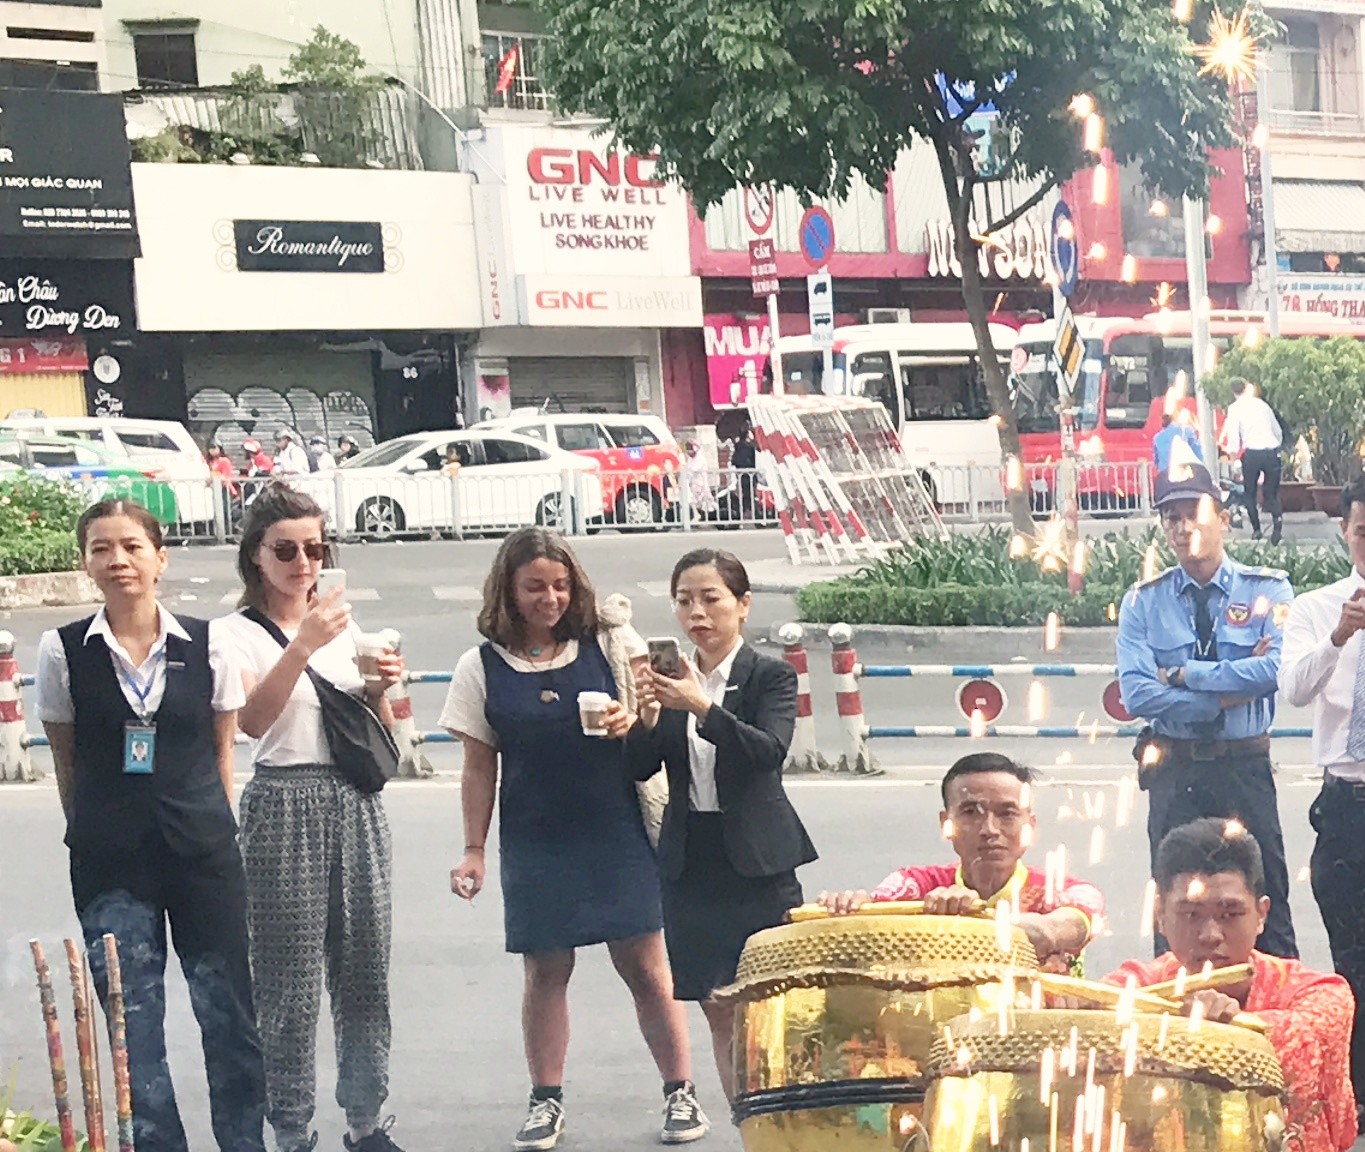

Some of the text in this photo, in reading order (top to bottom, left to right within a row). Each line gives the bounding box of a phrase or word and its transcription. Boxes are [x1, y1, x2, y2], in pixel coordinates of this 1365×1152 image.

[527, 147, 667, 188] GNC
[66, 178, 102, 189] QUAN
[529, 185, 666, 205] LIVE WELL
[541, 212, 656, 230] LIVE HEALTHY
[247, 226, 373, 266] Romantique
[535, 290, 608, 310] GNC
